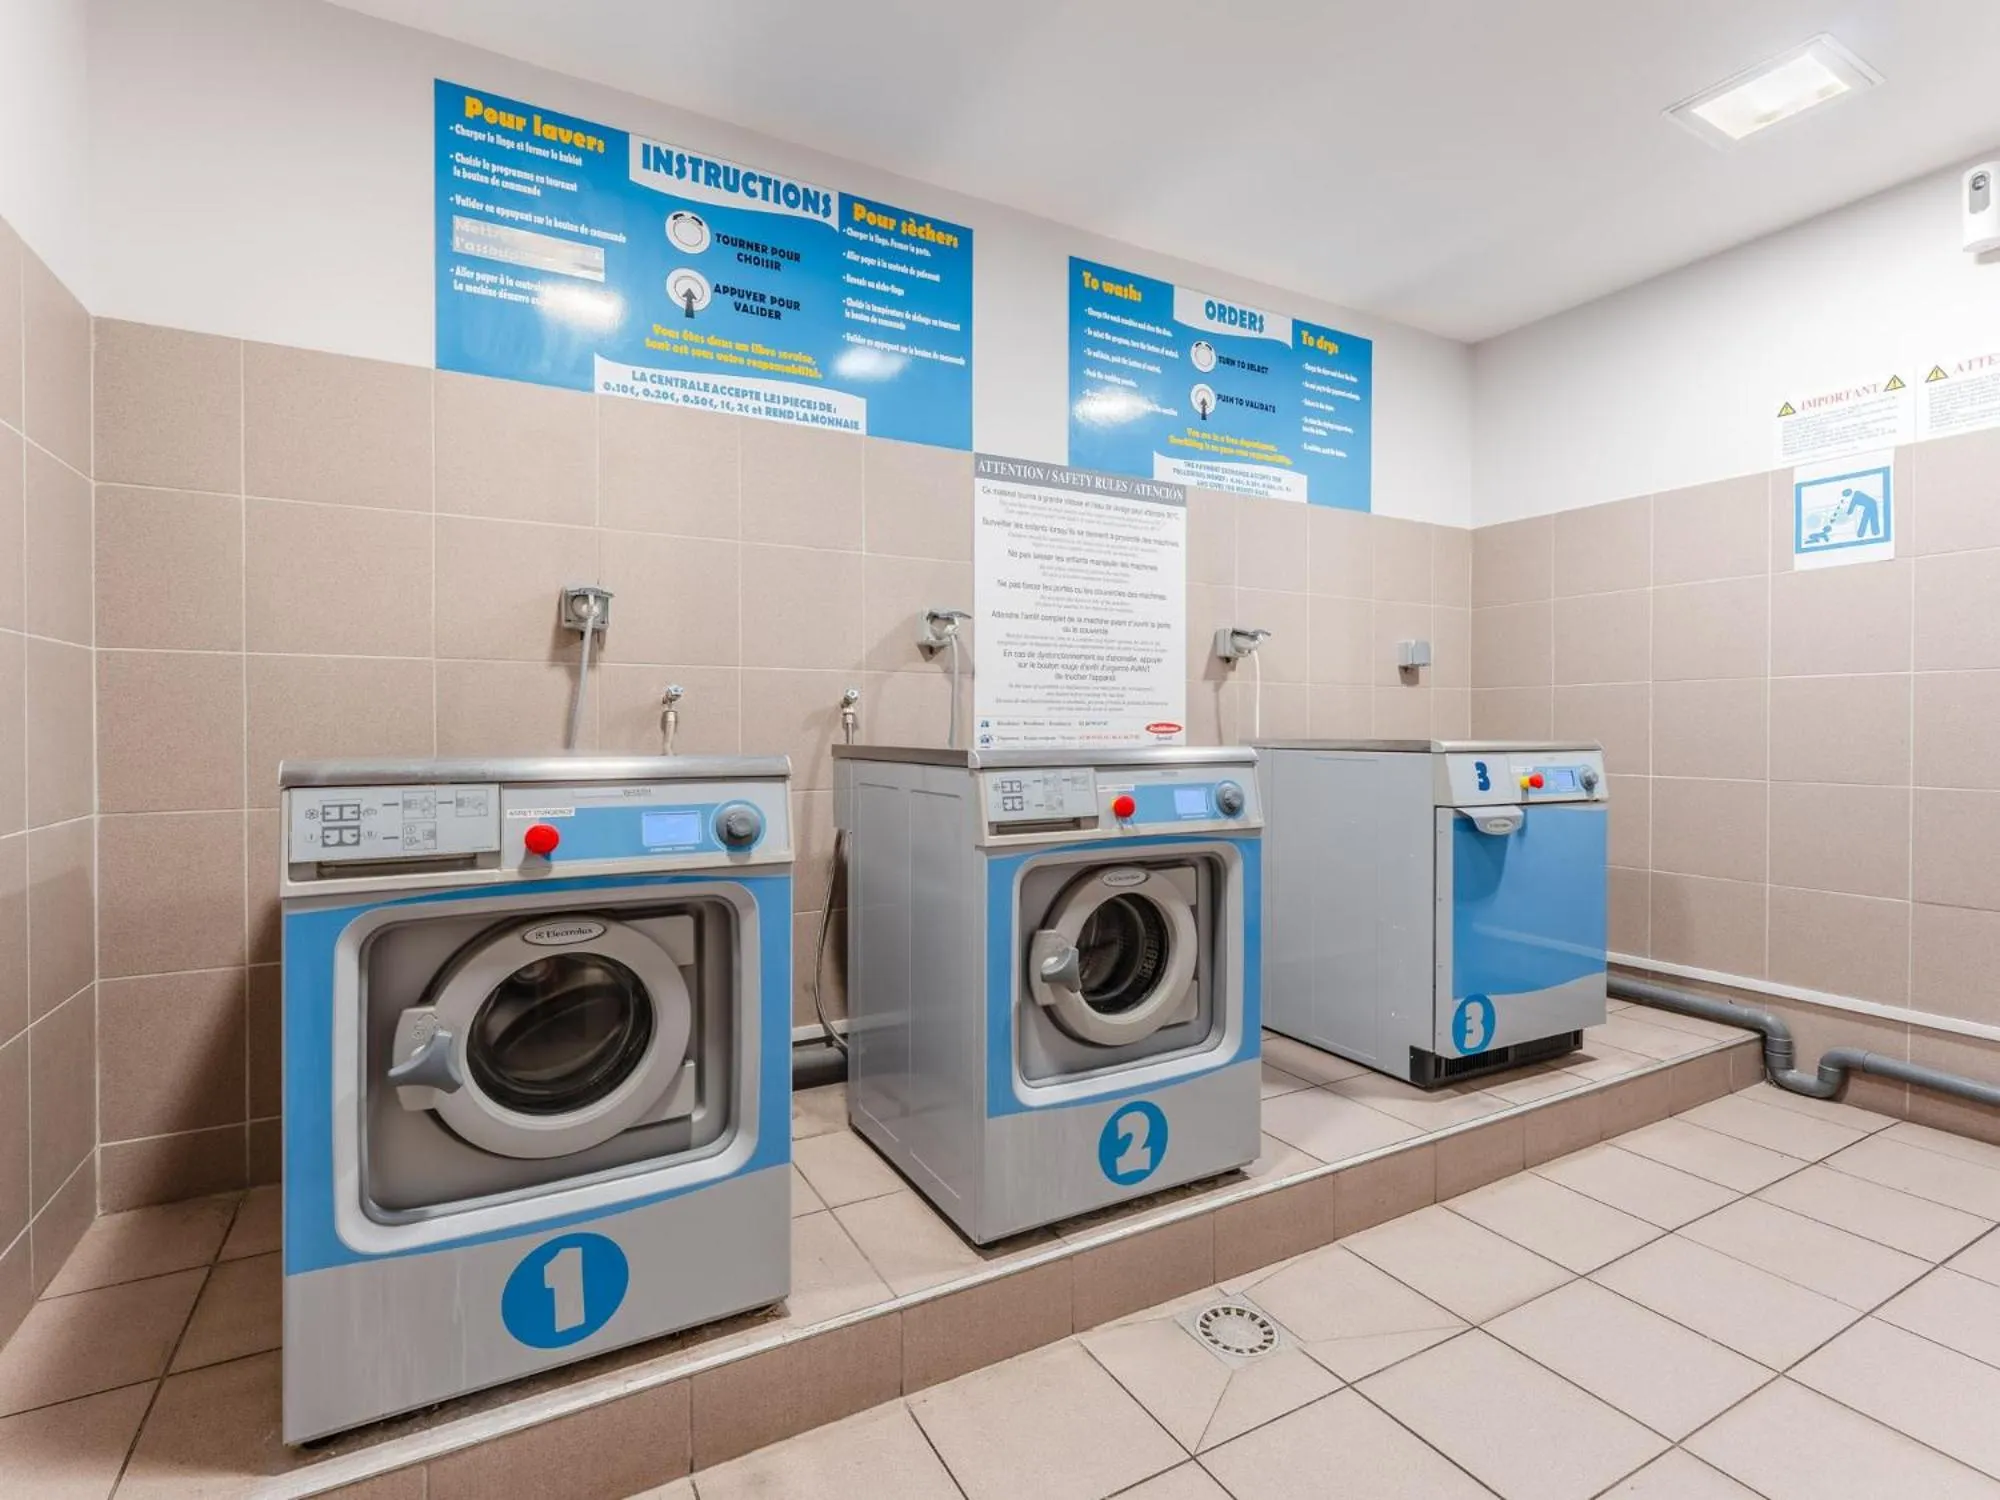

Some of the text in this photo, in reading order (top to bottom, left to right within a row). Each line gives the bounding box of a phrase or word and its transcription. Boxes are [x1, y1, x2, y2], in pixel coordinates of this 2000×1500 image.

[465, 95, 527, 133] Pour
[641, 143, 832, 219] INSTRUCTIONS
[853, 203, 896, 231] Pour
[716, 233, 801, 262] TOURNER POUR
[737, 252, 781, 271] CHOISIR
[1082, 271, 1099, 291] To
[714, 284, 801, 311] APPUYER POUR
[734, 302, 781, 320] VALIDER
[1205, 300, 1265, 334] ORDERS
[1301, 331, 1315, 347] To
[1218, 356, 1269, 375] TURN TO SELECT
[632, 372, 648, 383] LA
[650, 374, 710, 393] CENTRALE
[712, 384, 761, 401] ACCEPTE
[764, 393, 781, 404] LES
[782, 396, 817, 409] PIECES
[1217, 393, 1276, 413] PUSH TO VALIDATE
[1801, 384, 1879, 411] IMPORTANT
[752, 405, 762, 415] et
[765, 407, 794, 419] REND
[796, 412, 809, 422] LA
[810, 414, 860, 429] MONNAIE
[979, 459, 1044, 480] ATTENTION
[1046, 469, 1050, 481] /
[1052, 470, 1093, 487] SAFETY
[1095, 477, 1128, 492] RULES
[1475, 762, 1490, 791] 3
[546, 928, 592, 939] Electrolux
[1463, 1001, 1484, 1048] 3
[1116, 1111, 1151, 1175] 2
[544, 1247, 585, 1332] 1
